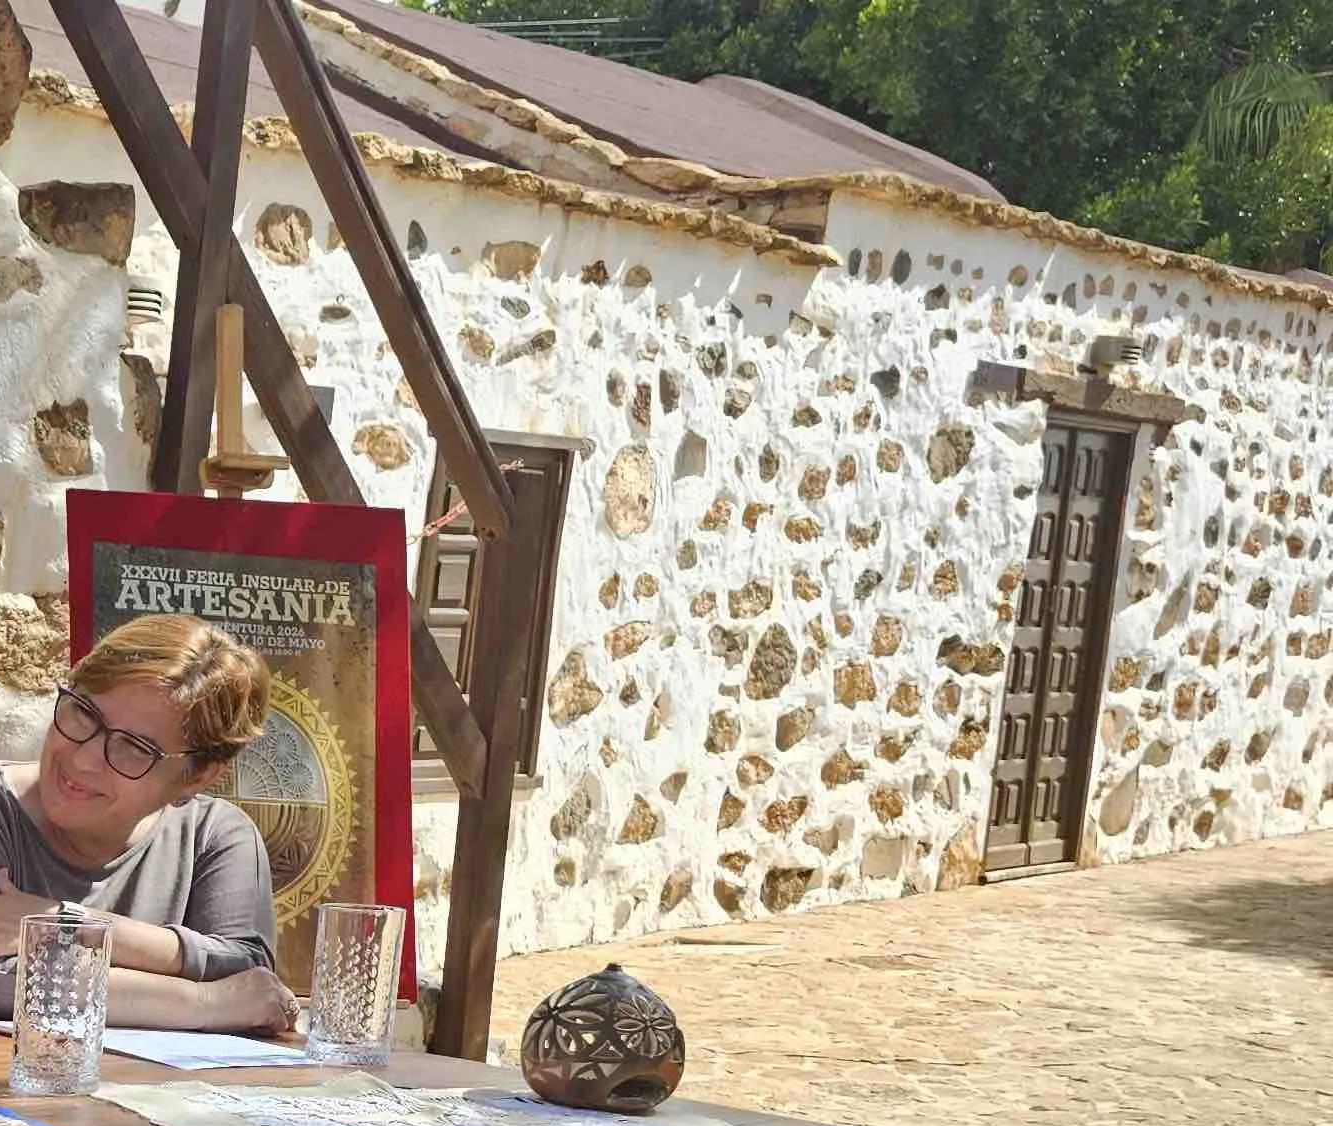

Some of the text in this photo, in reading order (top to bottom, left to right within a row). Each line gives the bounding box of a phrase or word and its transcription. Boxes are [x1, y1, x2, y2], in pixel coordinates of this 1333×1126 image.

[121, 564, 350, 597] XXXVII FERIA INSULAR DE
[114, 579, 355, 627] ARTESANÍA
[267, 636, 286, 647] DE
[288, 637, 326, 650] MAYO
